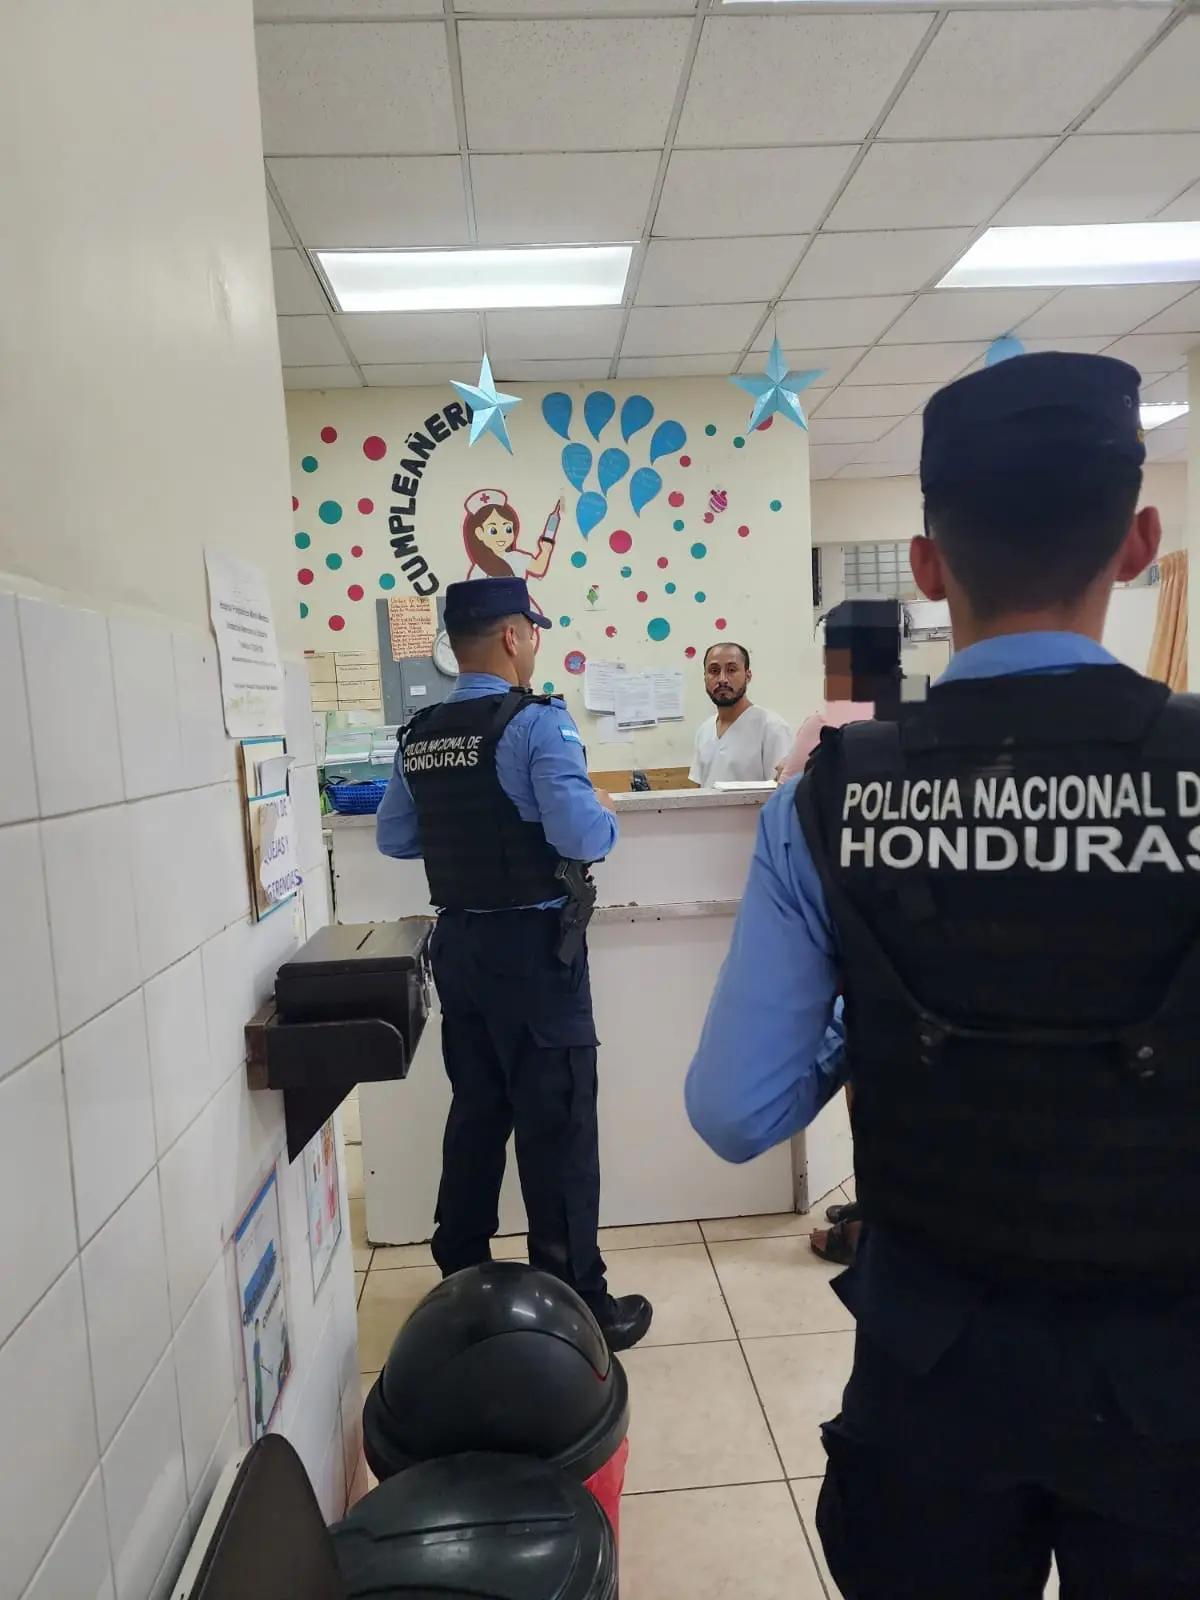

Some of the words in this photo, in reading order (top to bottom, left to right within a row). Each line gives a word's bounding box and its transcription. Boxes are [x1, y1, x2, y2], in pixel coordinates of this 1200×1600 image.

[403, 741, 428, 757] POLICIA
[427, 736, 466, 752] NACIONAL
[466, 735, 483, 749] DE
[403, 750, 479, 773] HONDURAS
[841, 778, 963, 821] POLICIA
[972, 770, 1166, 821] NACIONAL
[264, 836, 285, 865] UEJAS
